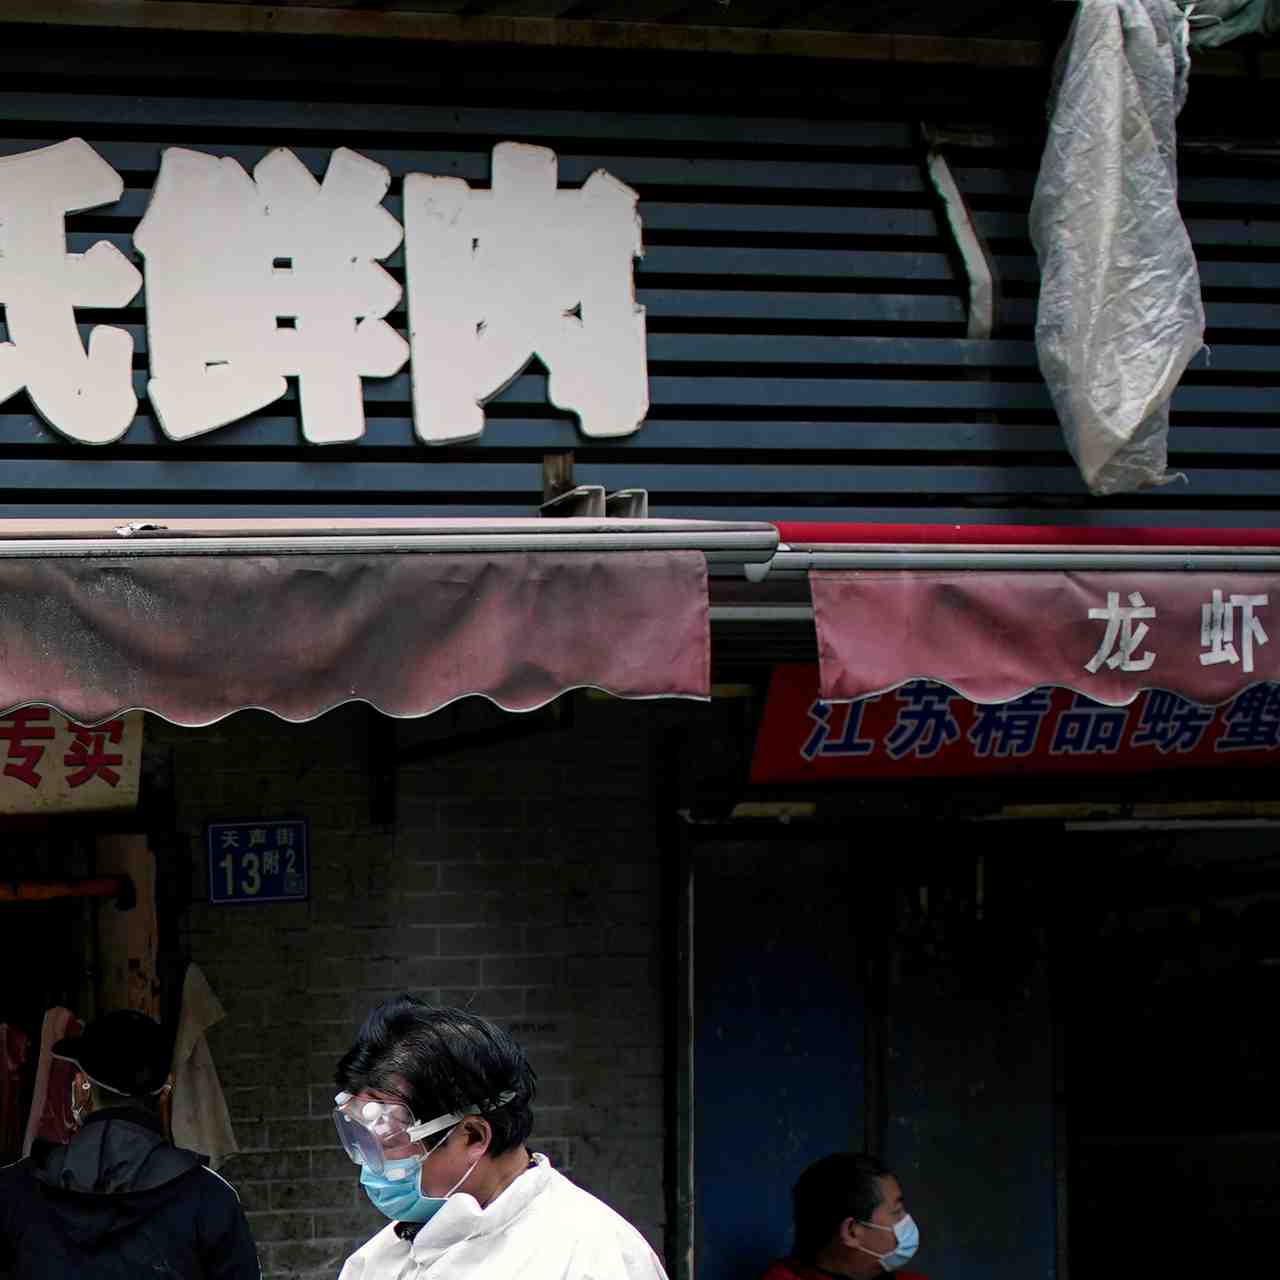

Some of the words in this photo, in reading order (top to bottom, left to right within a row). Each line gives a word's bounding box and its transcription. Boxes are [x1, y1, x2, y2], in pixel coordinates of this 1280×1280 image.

[1083, 589, 1269, 673] 龙虾
[220, 827, 297, 848] 天声街
